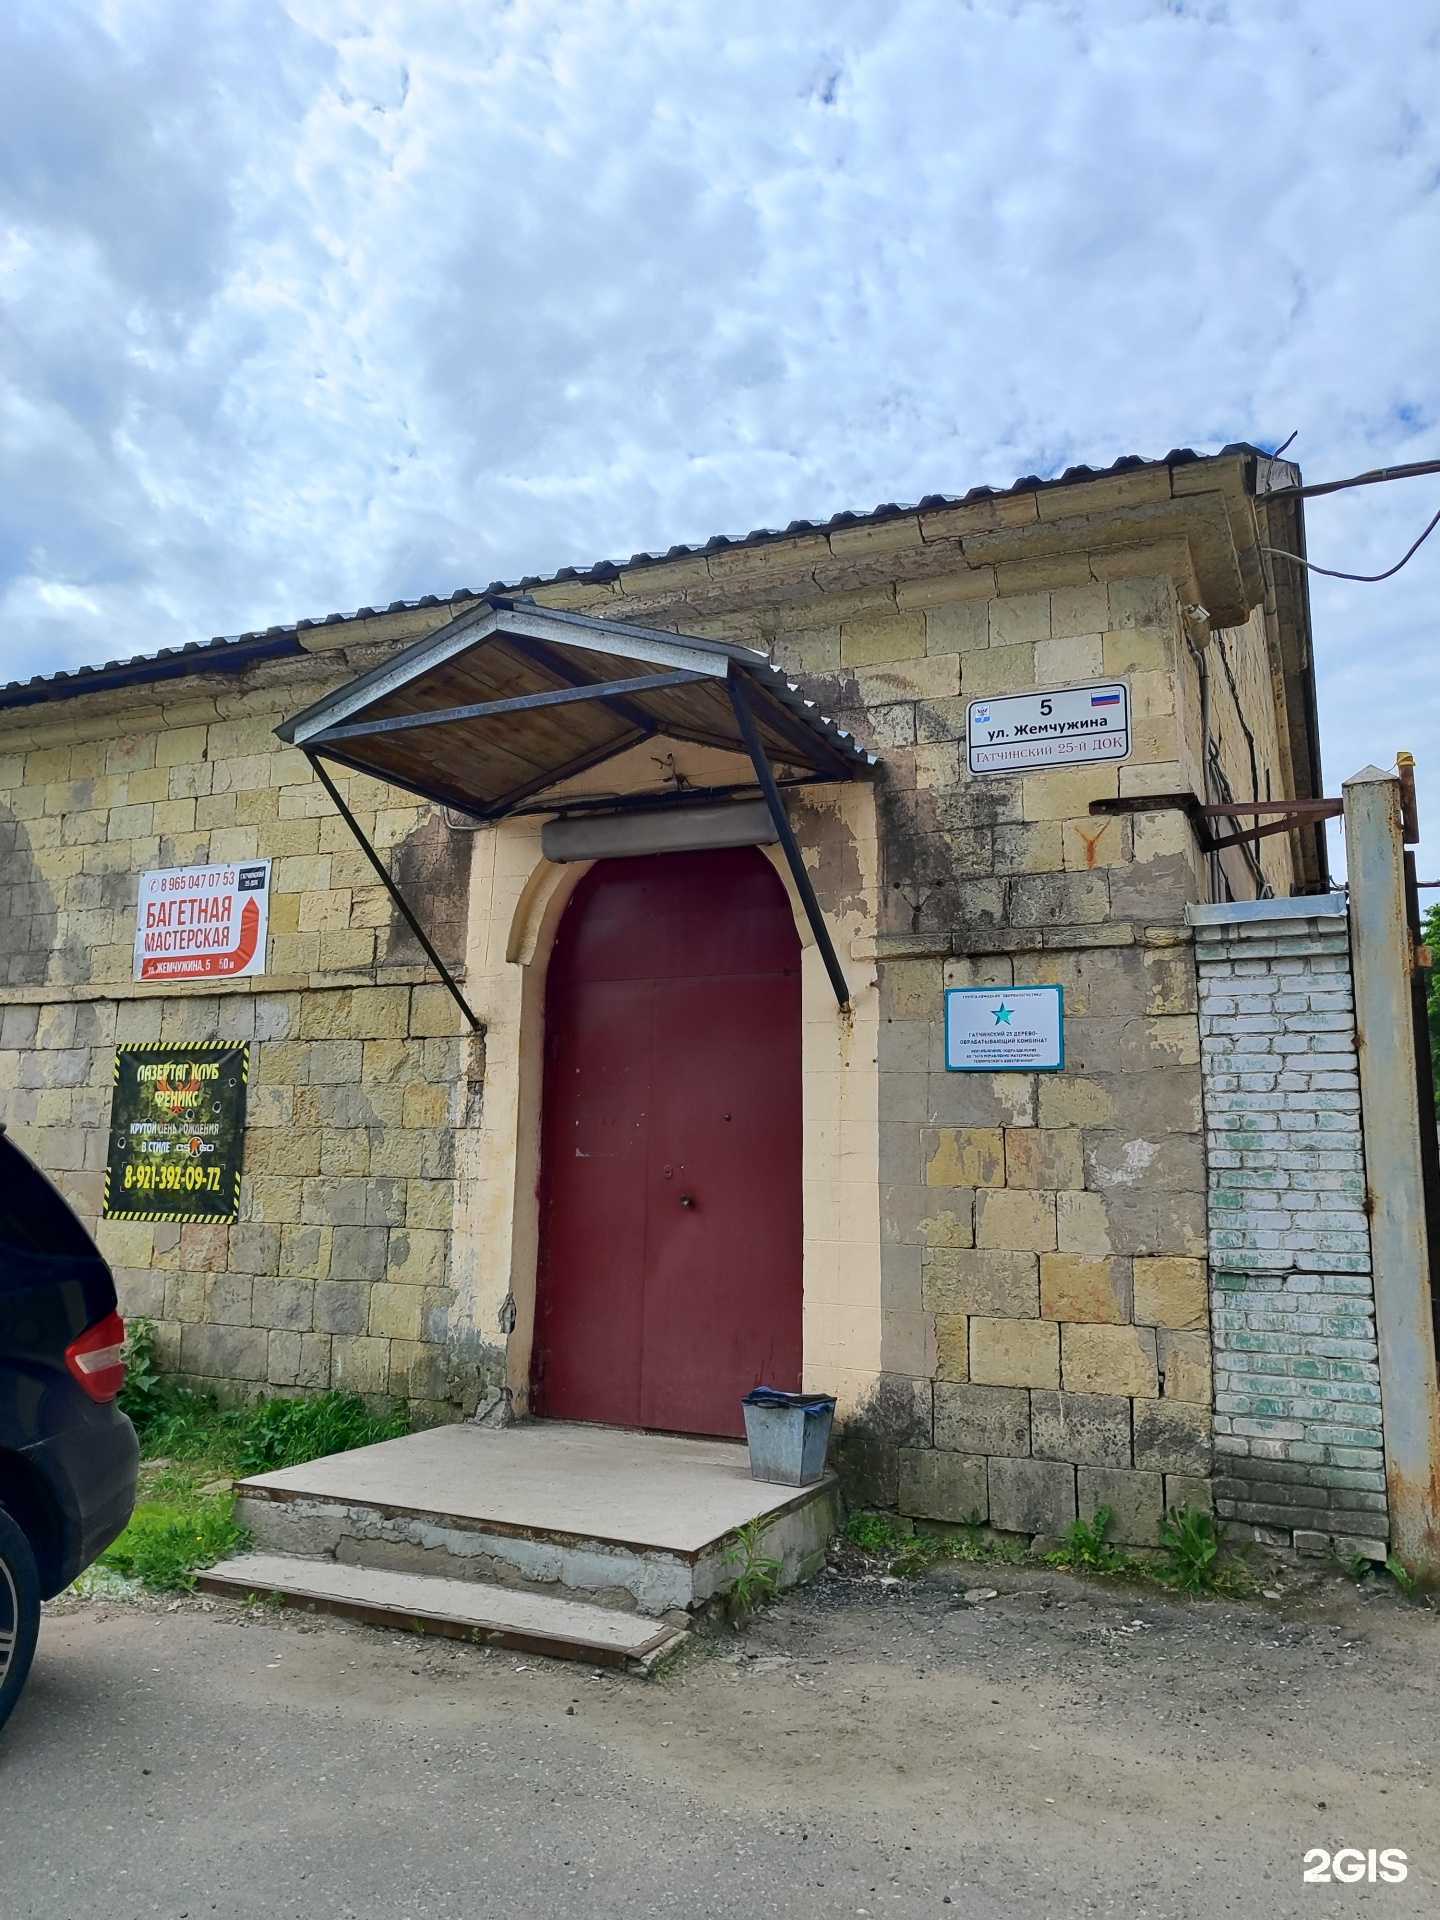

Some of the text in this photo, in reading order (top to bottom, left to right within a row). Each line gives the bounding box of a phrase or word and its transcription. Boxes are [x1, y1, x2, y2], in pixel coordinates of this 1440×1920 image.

[1040, 699, 1053, 716] 5
[988, 717, 1108, 742] ул. Жемчужина
[1092, 736, 1124, 752] ДОК
[161, 880, 167, 892] 8
[169, 876, 186, 891] 965
[188, 874, 206, 889] 047
[208, 873, 220, 887] 07
[222, 872, 235, 886] 53
[146, 895, 233, 929] БАГЕТНАЯ
[145, 926, 230, 953] МАСТЕРСКАЯ
[155, 959, 204, 974] ЖЕМЧУЖИНА,
[205, 959, 211, 970] 5
[137, 1063, 220, 1082] ЛАЗЕРТАГ КЛУБ
[154, 1090, 199, 1108] ФЕНИКС
[130, 1121, 157, 1135] КРУТОЙ
[141, 1141, 171, 1153] В СТИЛЕ
[124, 1164, 221, 1191] 8-921-392-09-72
